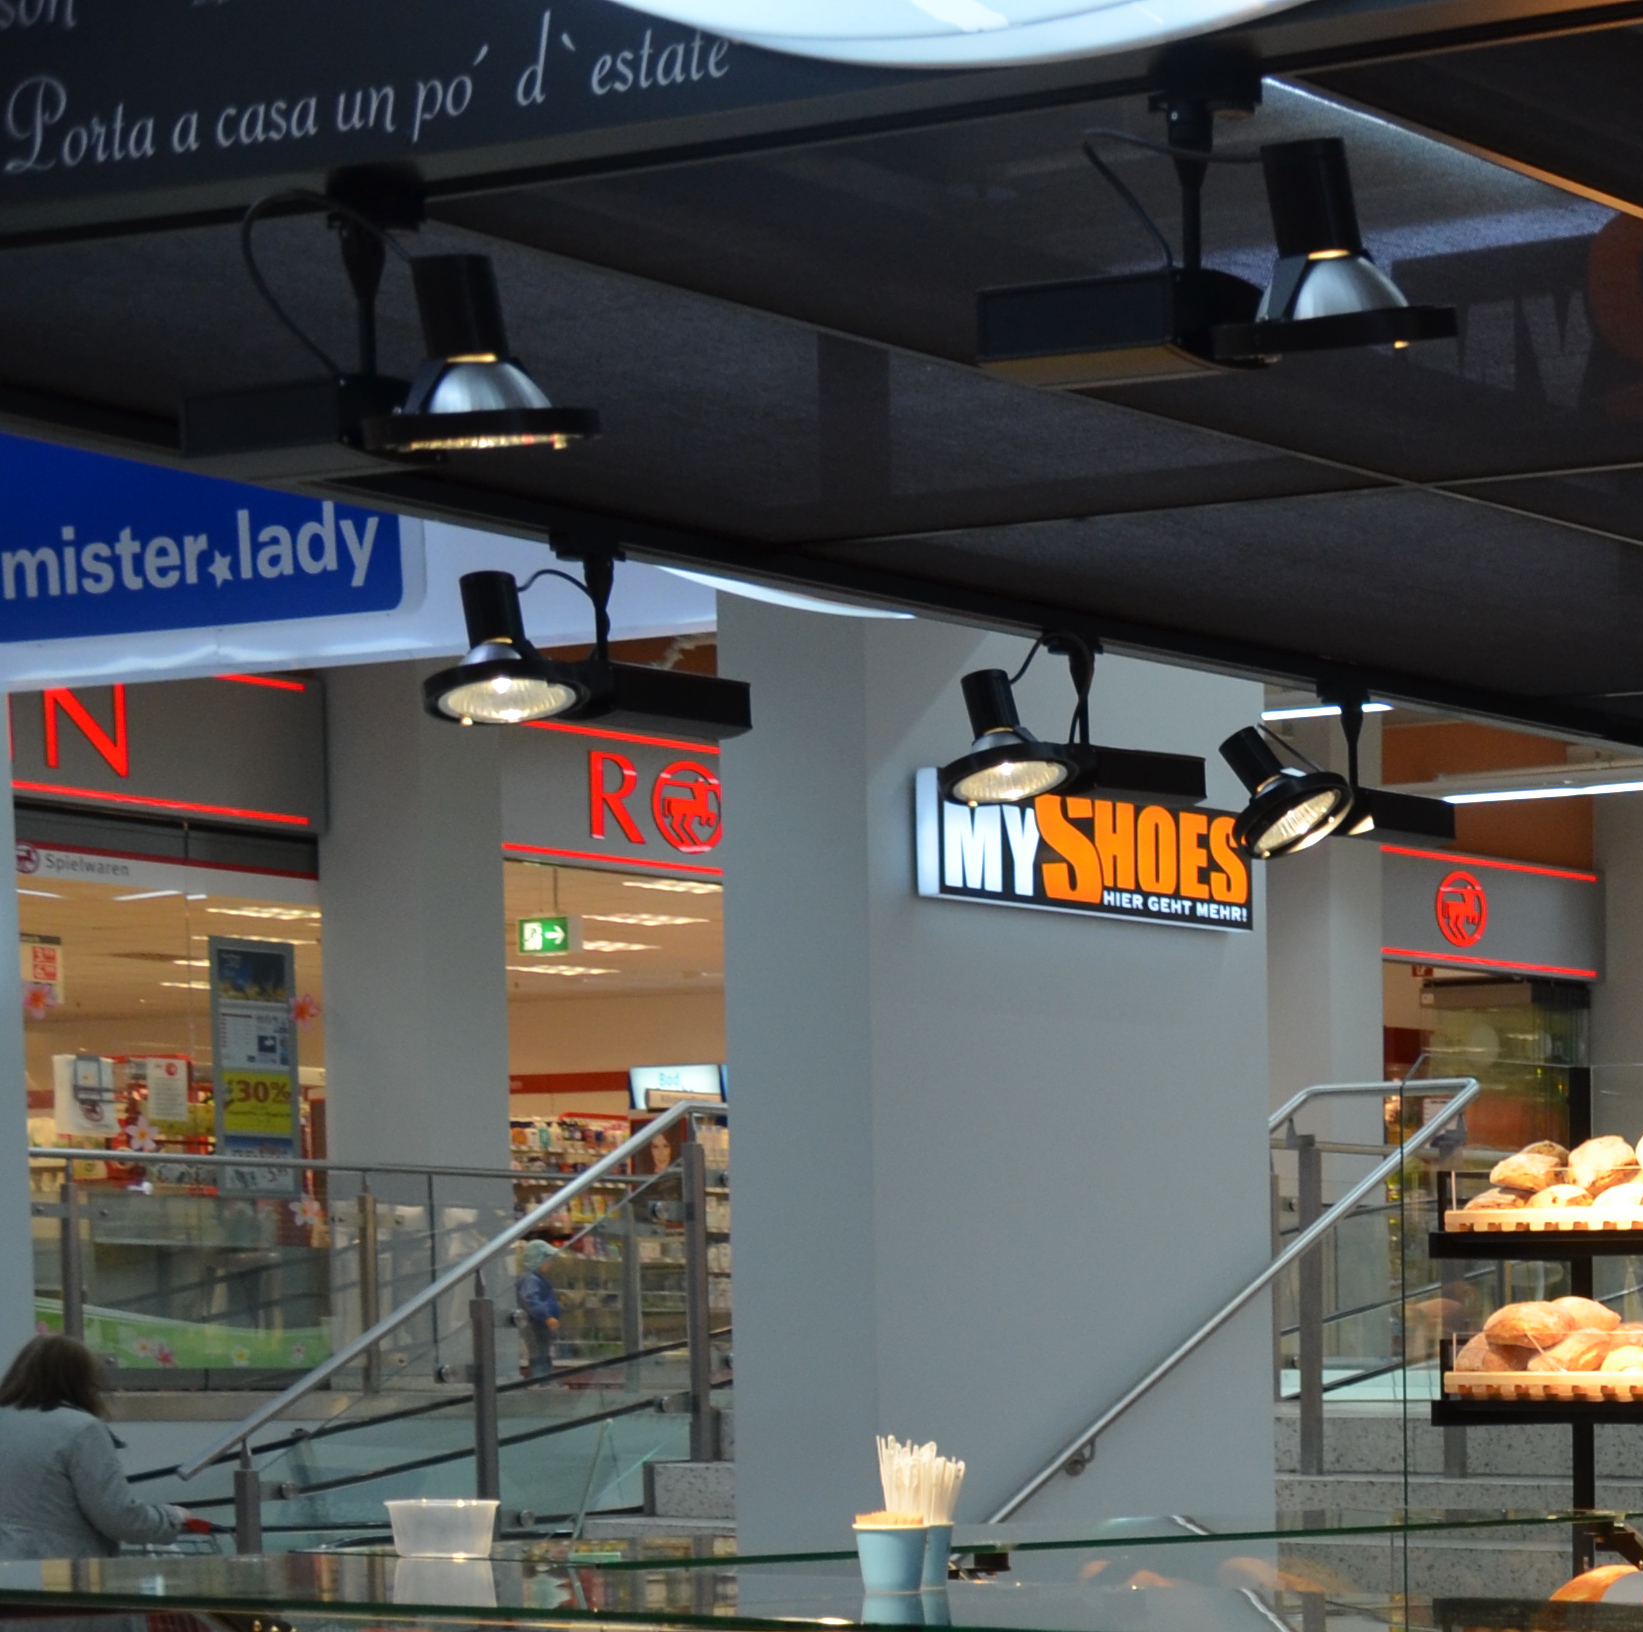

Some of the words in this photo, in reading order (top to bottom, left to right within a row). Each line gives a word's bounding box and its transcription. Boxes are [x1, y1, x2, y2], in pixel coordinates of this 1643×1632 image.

[3, 75, 156, 173] Porta
[171, 110, 199, 153] a
[215, 97, 319, 148] casa
[335, 86, 396, 133] un
[1, 525, 208, 600] mister
[236, 500, 380, 588] lady
[44, 852, 131, 877] Spielwaren
[1102, 889, 1144, 910] HIER
[1146, 895, 1193, 917] GEHT
[1195, 902, 1248, 923] MEHR!
